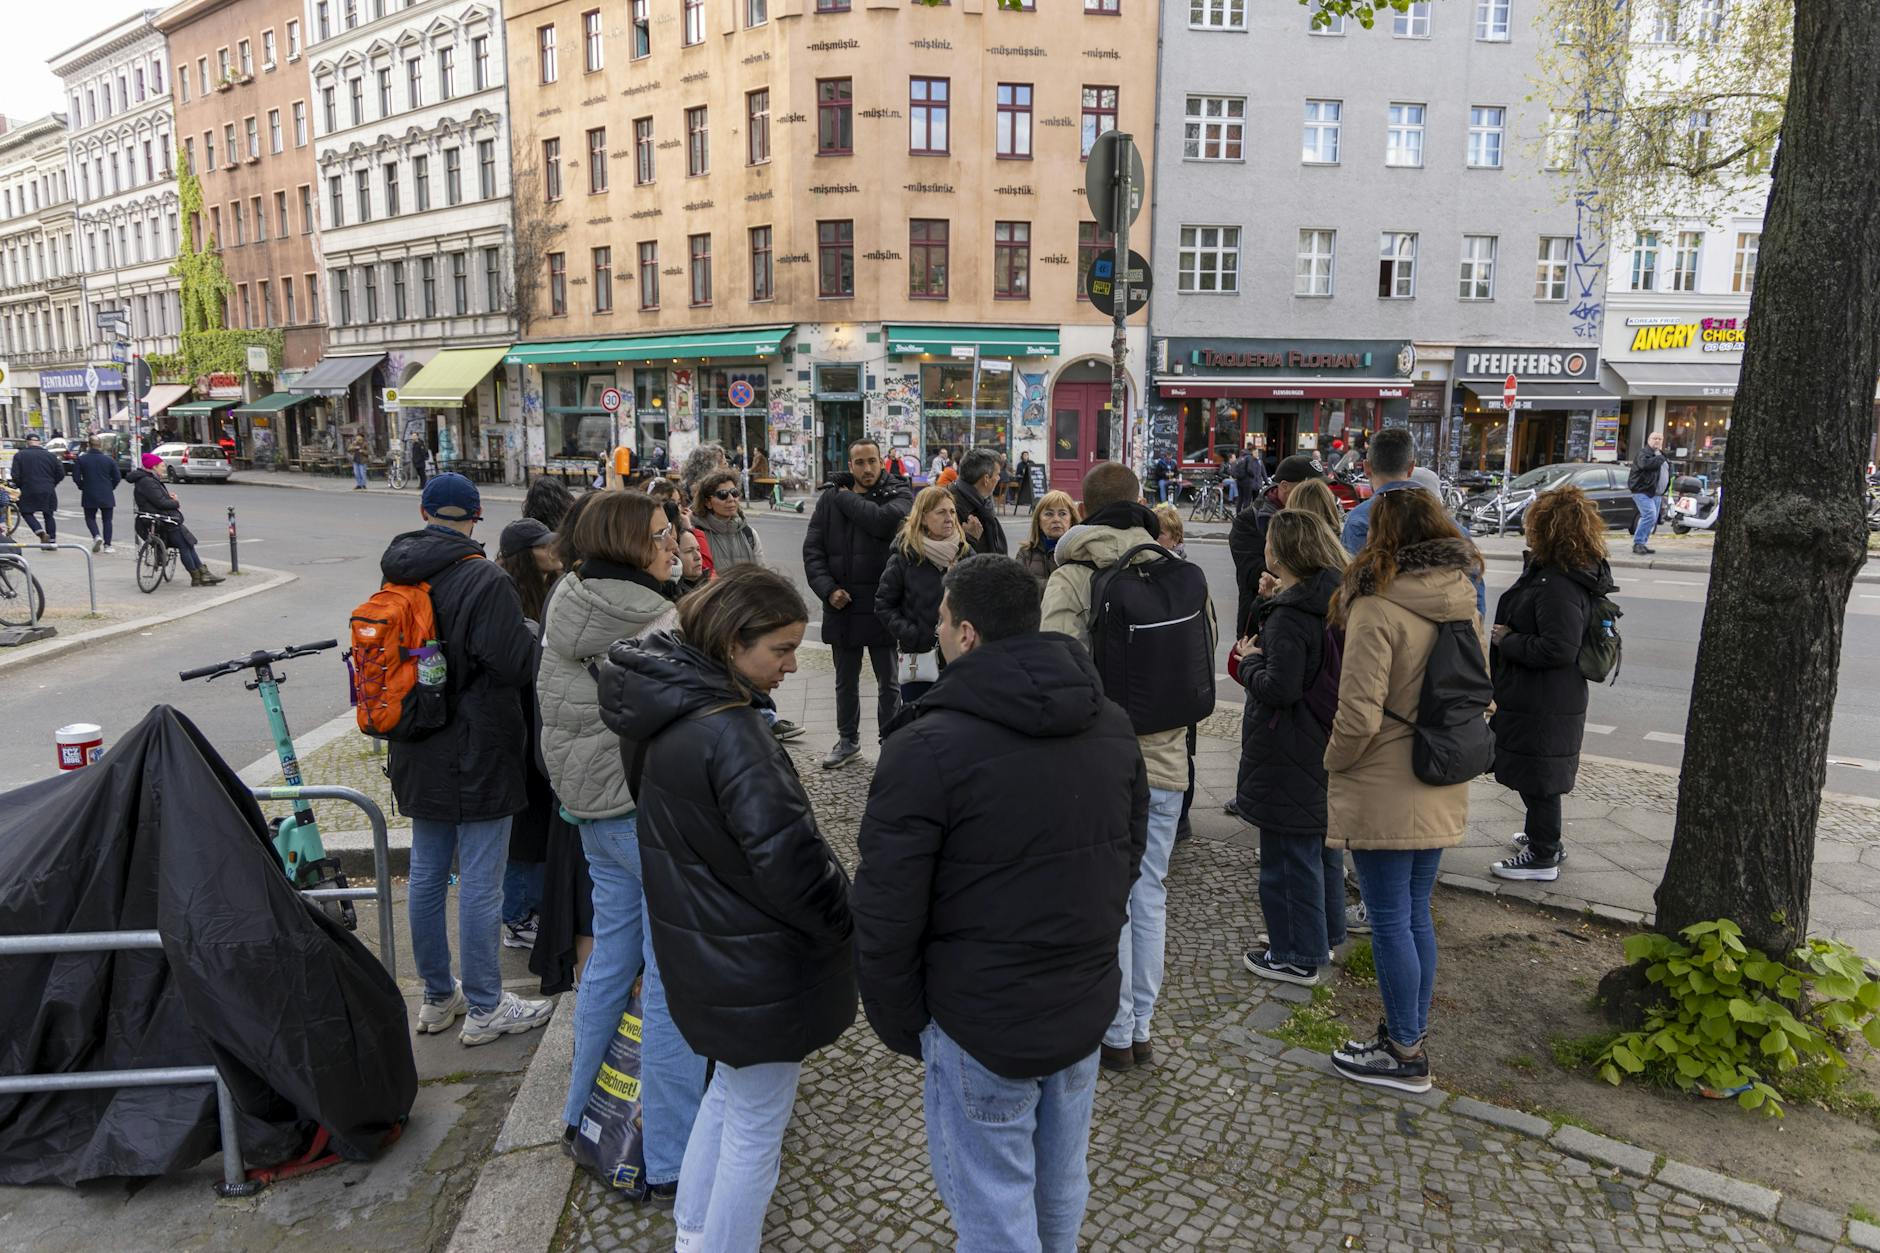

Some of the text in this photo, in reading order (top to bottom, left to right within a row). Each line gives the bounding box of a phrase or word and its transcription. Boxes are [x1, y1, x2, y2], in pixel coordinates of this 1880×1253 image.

[1040, 253, 1070, 265] -mişiz.
[1631, 323, 1699, 351] ANGRY
[1201, 348, 1360, 368] TAQUERIA FLORIAN
[1466, 353, 1563, 375] PFEIFFERS
[42, 374, 84, 389] ZENTRALRAD
[605, 394, 617, 406] 30
